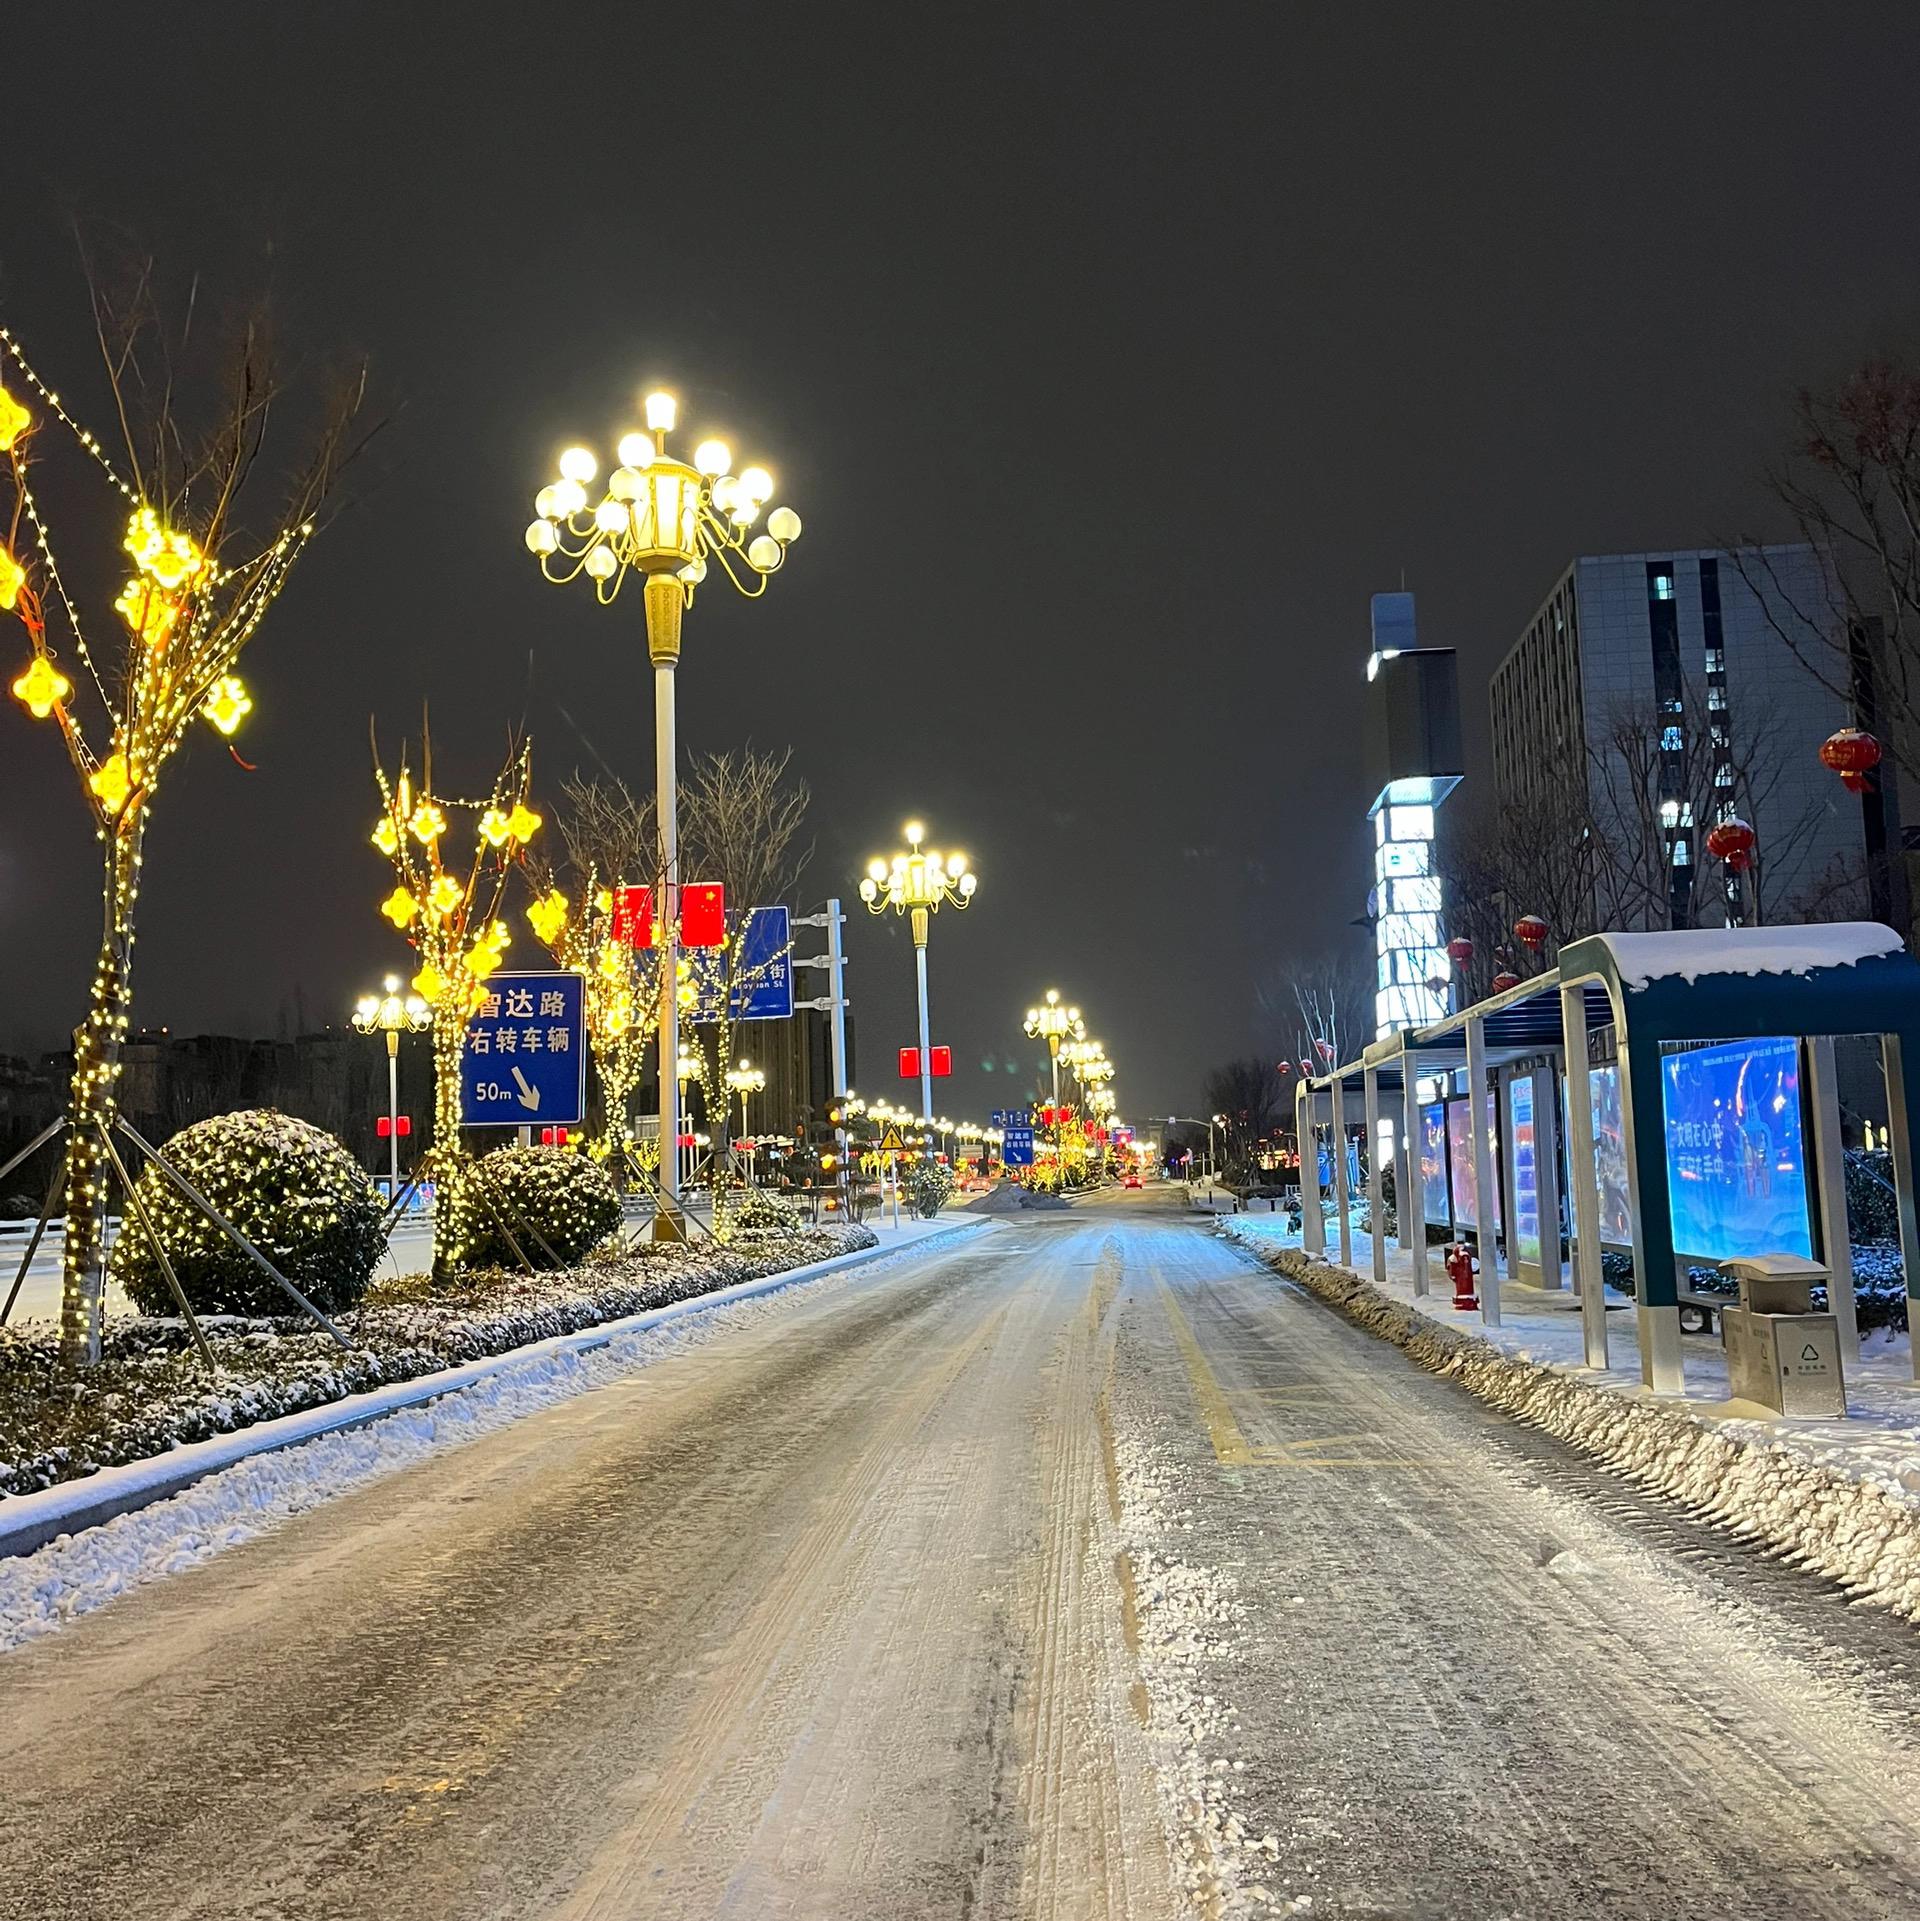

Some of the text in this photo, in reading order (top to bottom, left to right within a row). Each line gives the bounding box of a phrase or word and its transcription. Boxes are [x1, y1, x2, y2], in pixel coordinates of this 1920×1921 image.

[478, 989, 566, 1018] 智达路
[470, 1026, 570, 1054] 右转车辆
[476, 1082, 512, 1101] 50m
